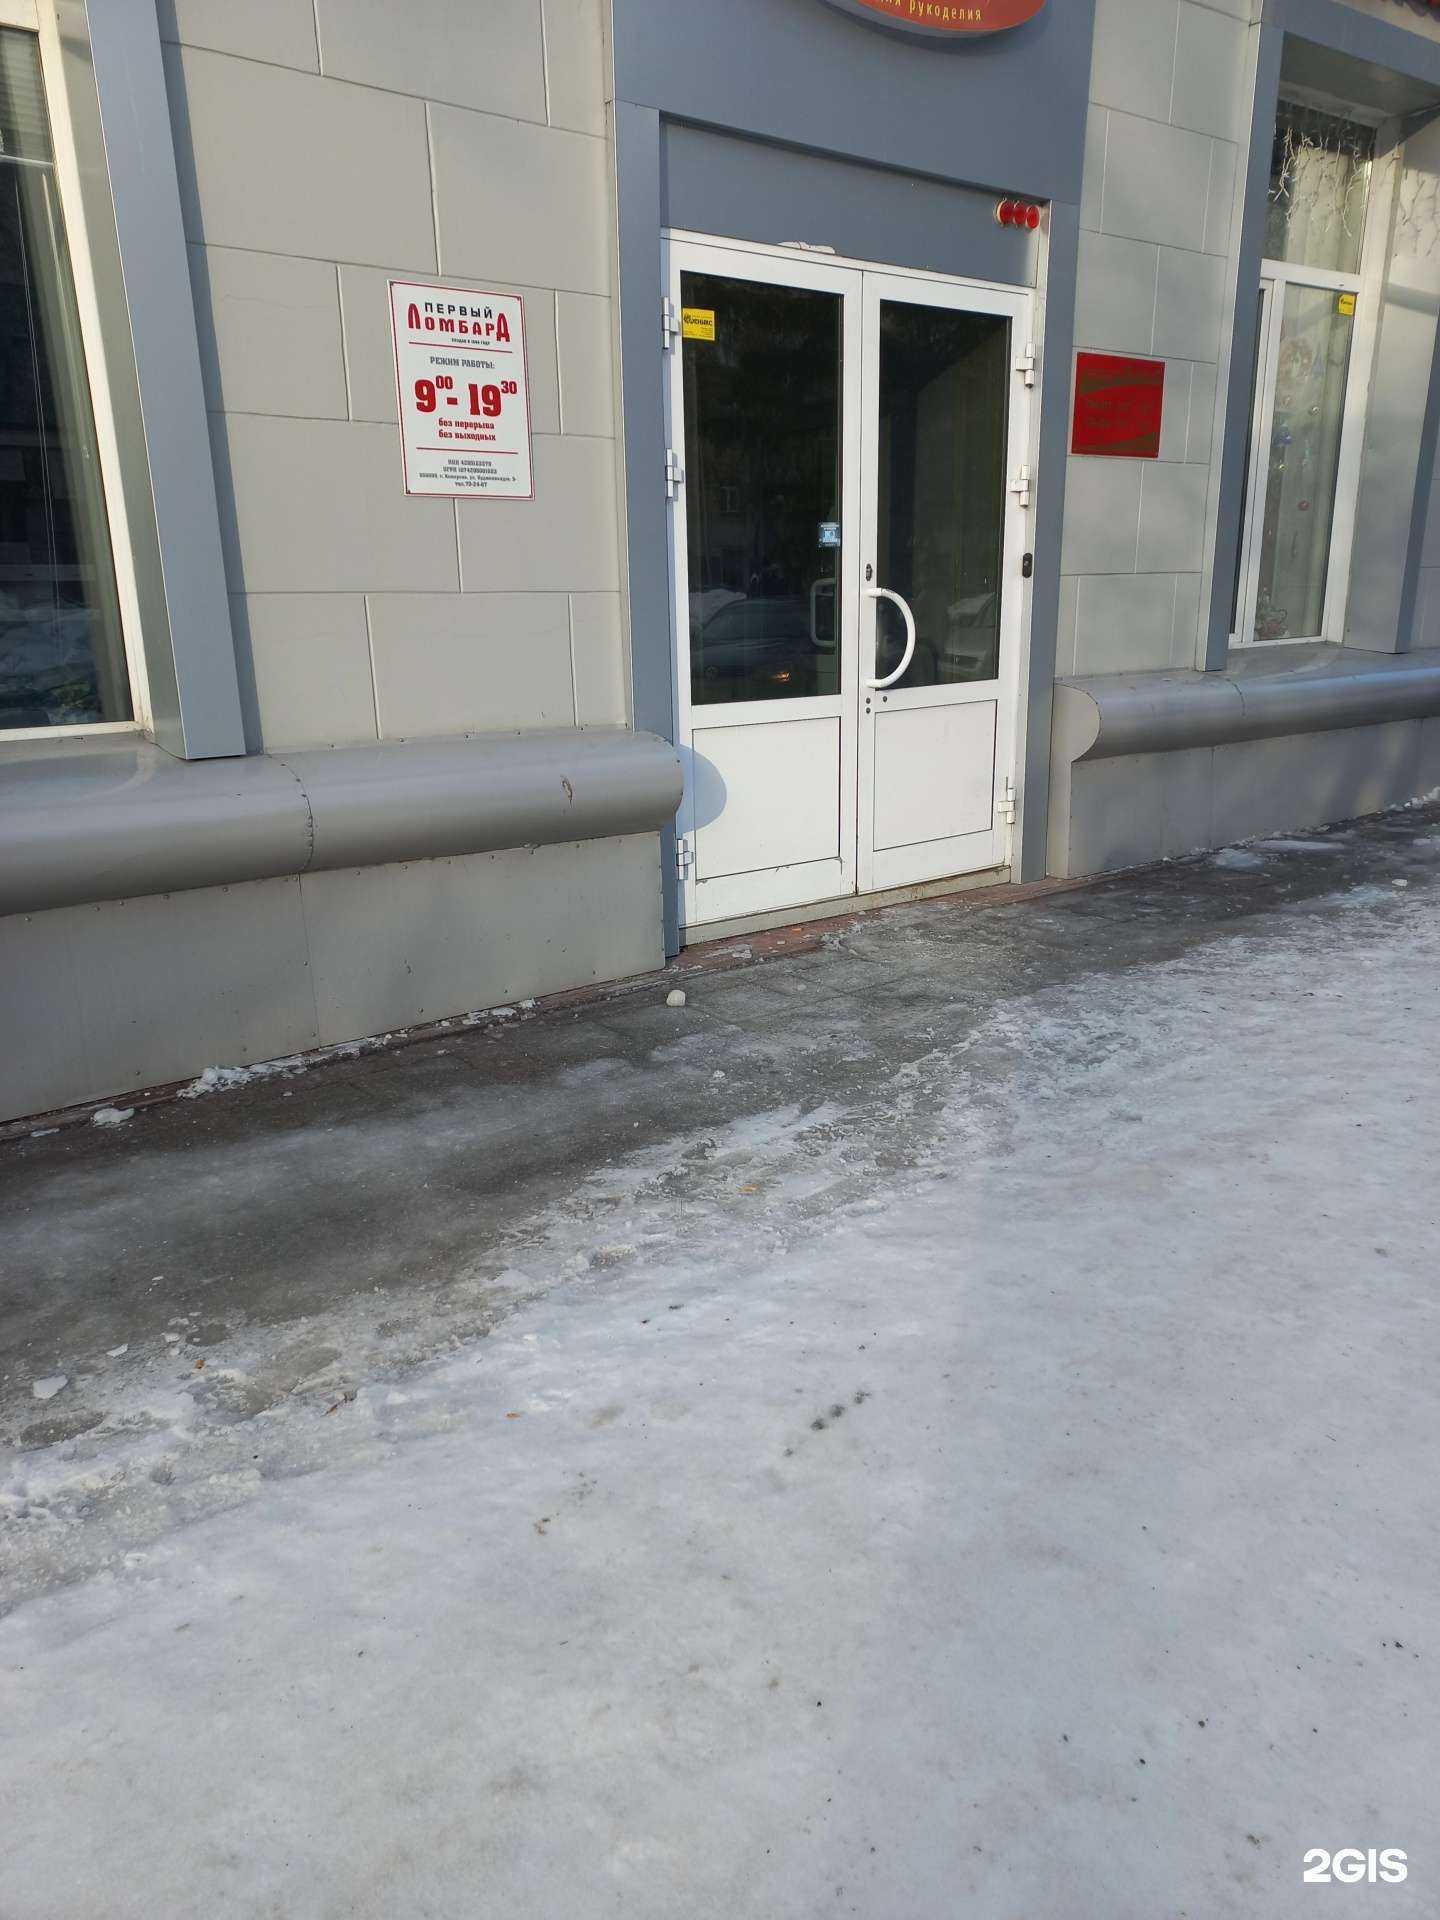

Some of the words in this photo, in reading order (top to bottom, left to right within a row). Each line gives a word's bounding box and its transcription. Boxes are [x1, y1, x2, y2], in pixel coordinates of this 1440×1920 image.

[909, 0, 982, 21] рукоделия
[424, 302, 493, 319] ПЕРВЫЙ
[430, 356, 459, 367] РЕЖИМ
[461, 358, 495, 369] РАБОТЫ:
[438, 417, 452, 427] без
[455, 420, 495, 431] перерыва
[438, 429, 452, 439] без
[455, 432, 496, 442] выходных
